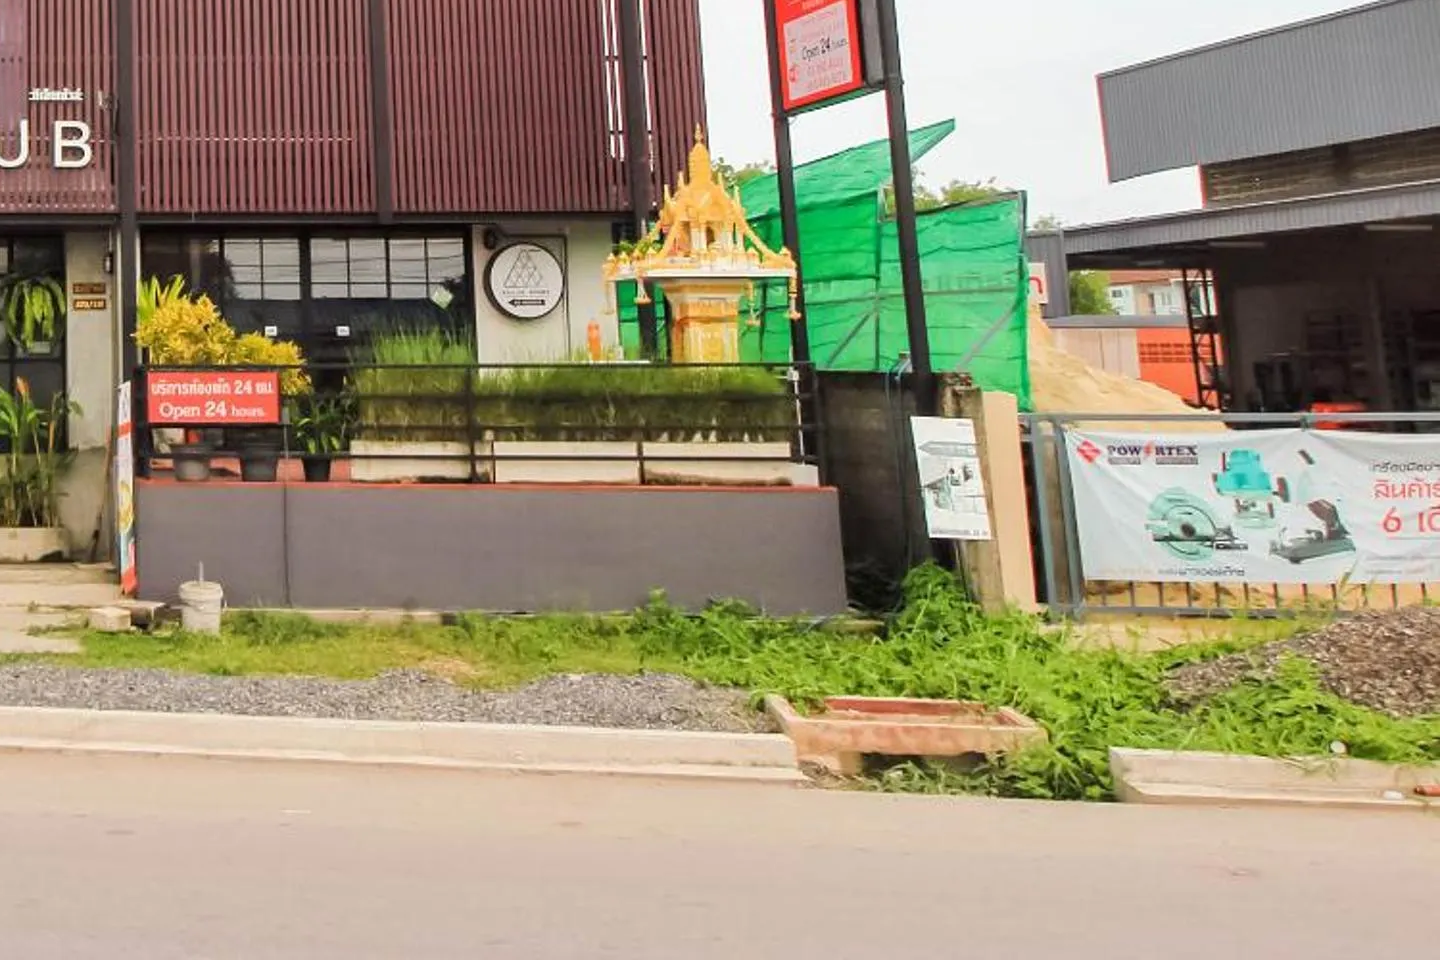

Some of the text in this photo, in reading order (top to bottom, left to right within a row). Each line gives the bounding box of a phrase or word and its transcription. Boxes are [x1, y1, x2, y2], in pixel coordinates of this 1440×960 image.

[234, 380, 252, 395] 24
[159, 402, 200, 420] Open
[205, 400, 227, 417] 24
[1383, 506, 1402, 533] 6
